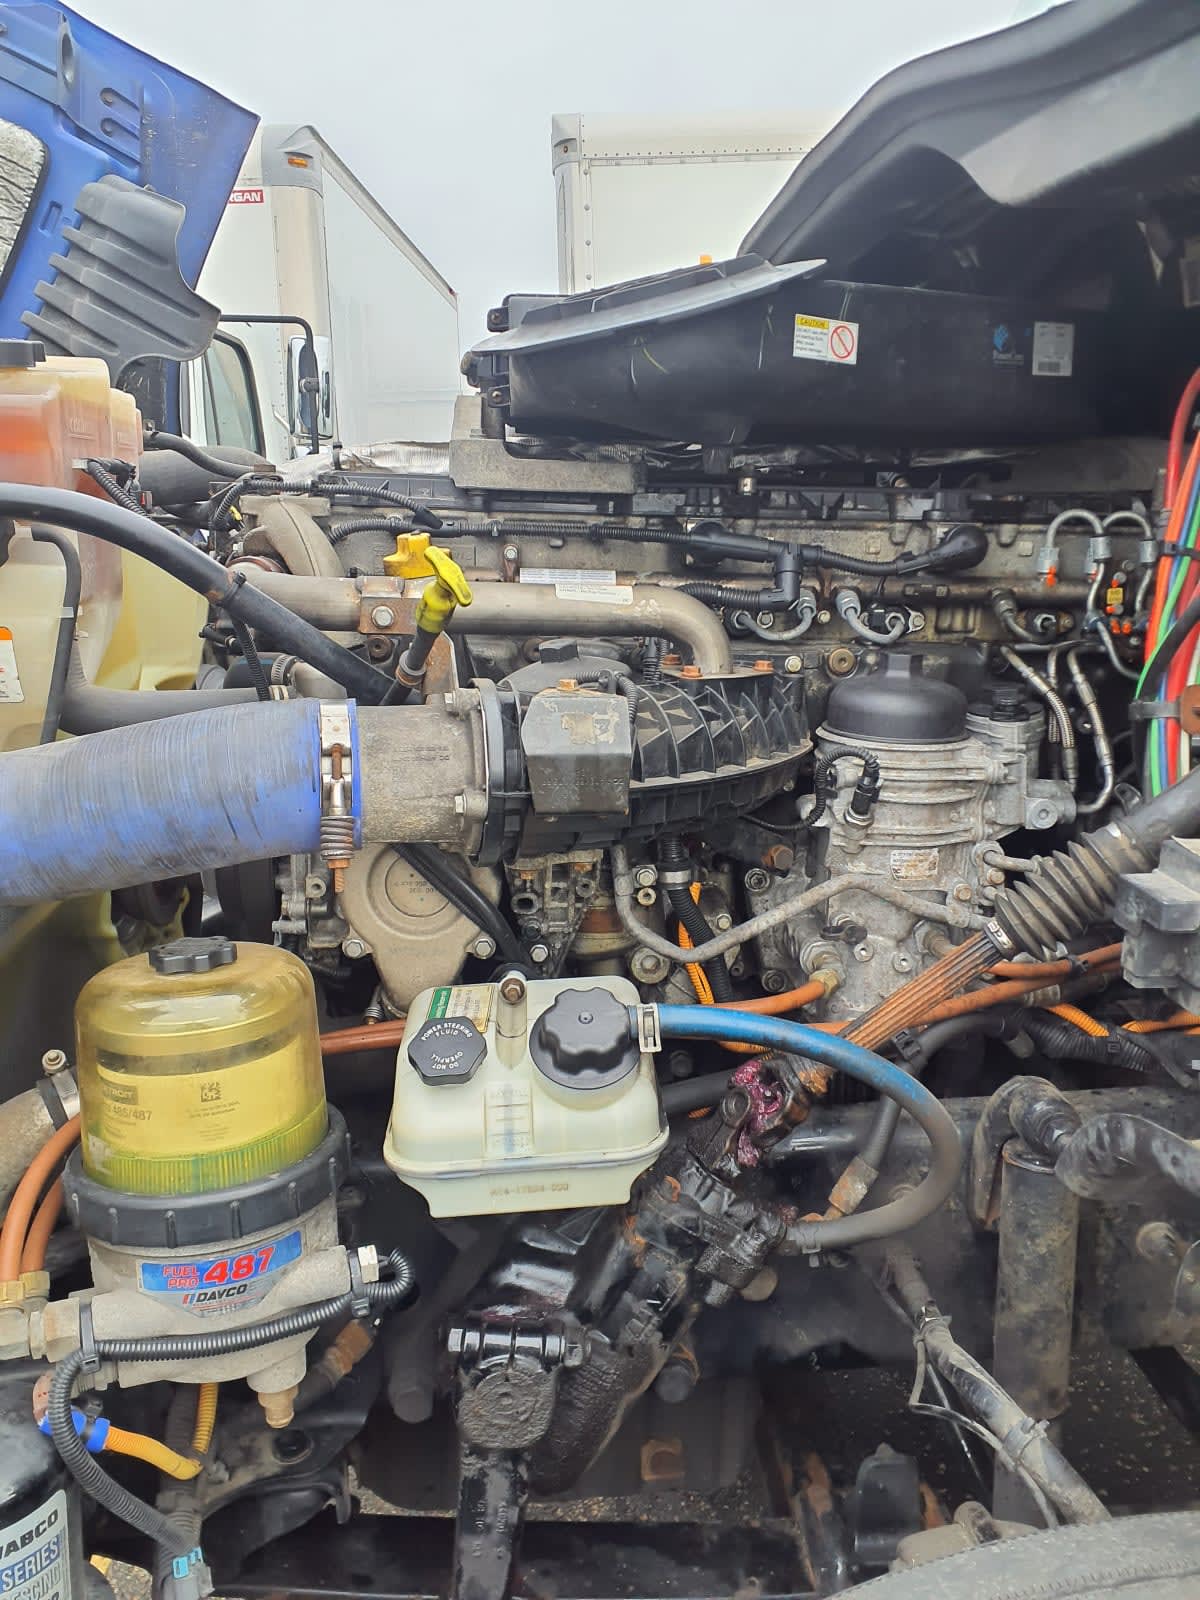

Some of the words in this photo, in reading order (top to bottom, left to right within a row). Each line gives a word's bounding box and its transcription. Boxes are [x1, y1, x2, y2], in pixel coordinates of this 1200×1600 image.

[421, 1024, 443, 1041] POWER
[443, 1022, 473, 1038] STEERING
[435, 1029, 459, 1037] FLUID
[163, 1264, 200, 1278] FUEL
[203, 1246, 275, 1285] 487
[167, 1277, 200, 1289] PRO
[0, 1509, 59, 1560] ABCO
[1, 1535, 59, 1592] SERIES
